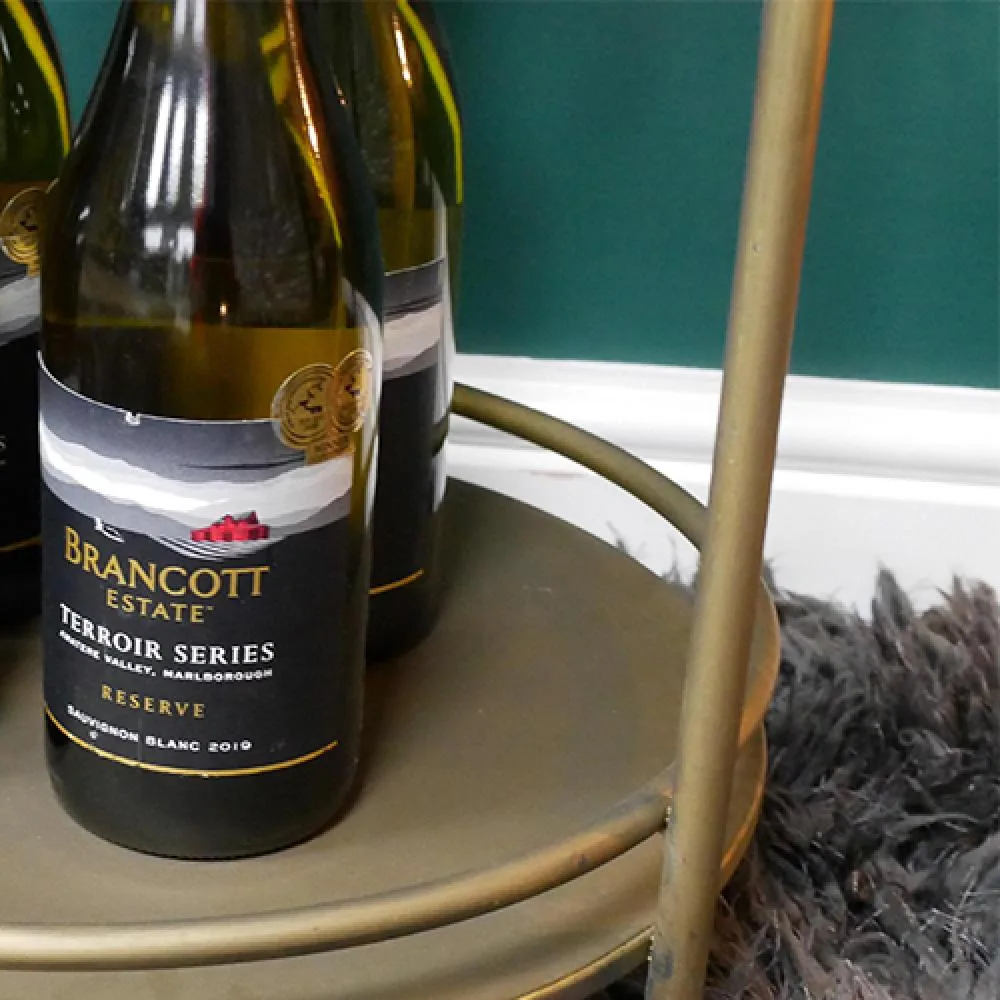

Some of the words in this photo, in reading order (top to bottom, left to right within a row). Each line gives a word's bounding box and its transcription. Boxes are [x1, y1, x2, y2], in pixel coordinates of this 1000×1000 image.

[65, 526, 269, 597] BRANCOTT
[106, 588, 205, 623] ESTATE
[60, 602, 162, 661] TERROIR
[174, 641, 275, 665] SERIES
[101, 684, 207, 719] RESERVE
[145, 735, 201, 752] BLANC
